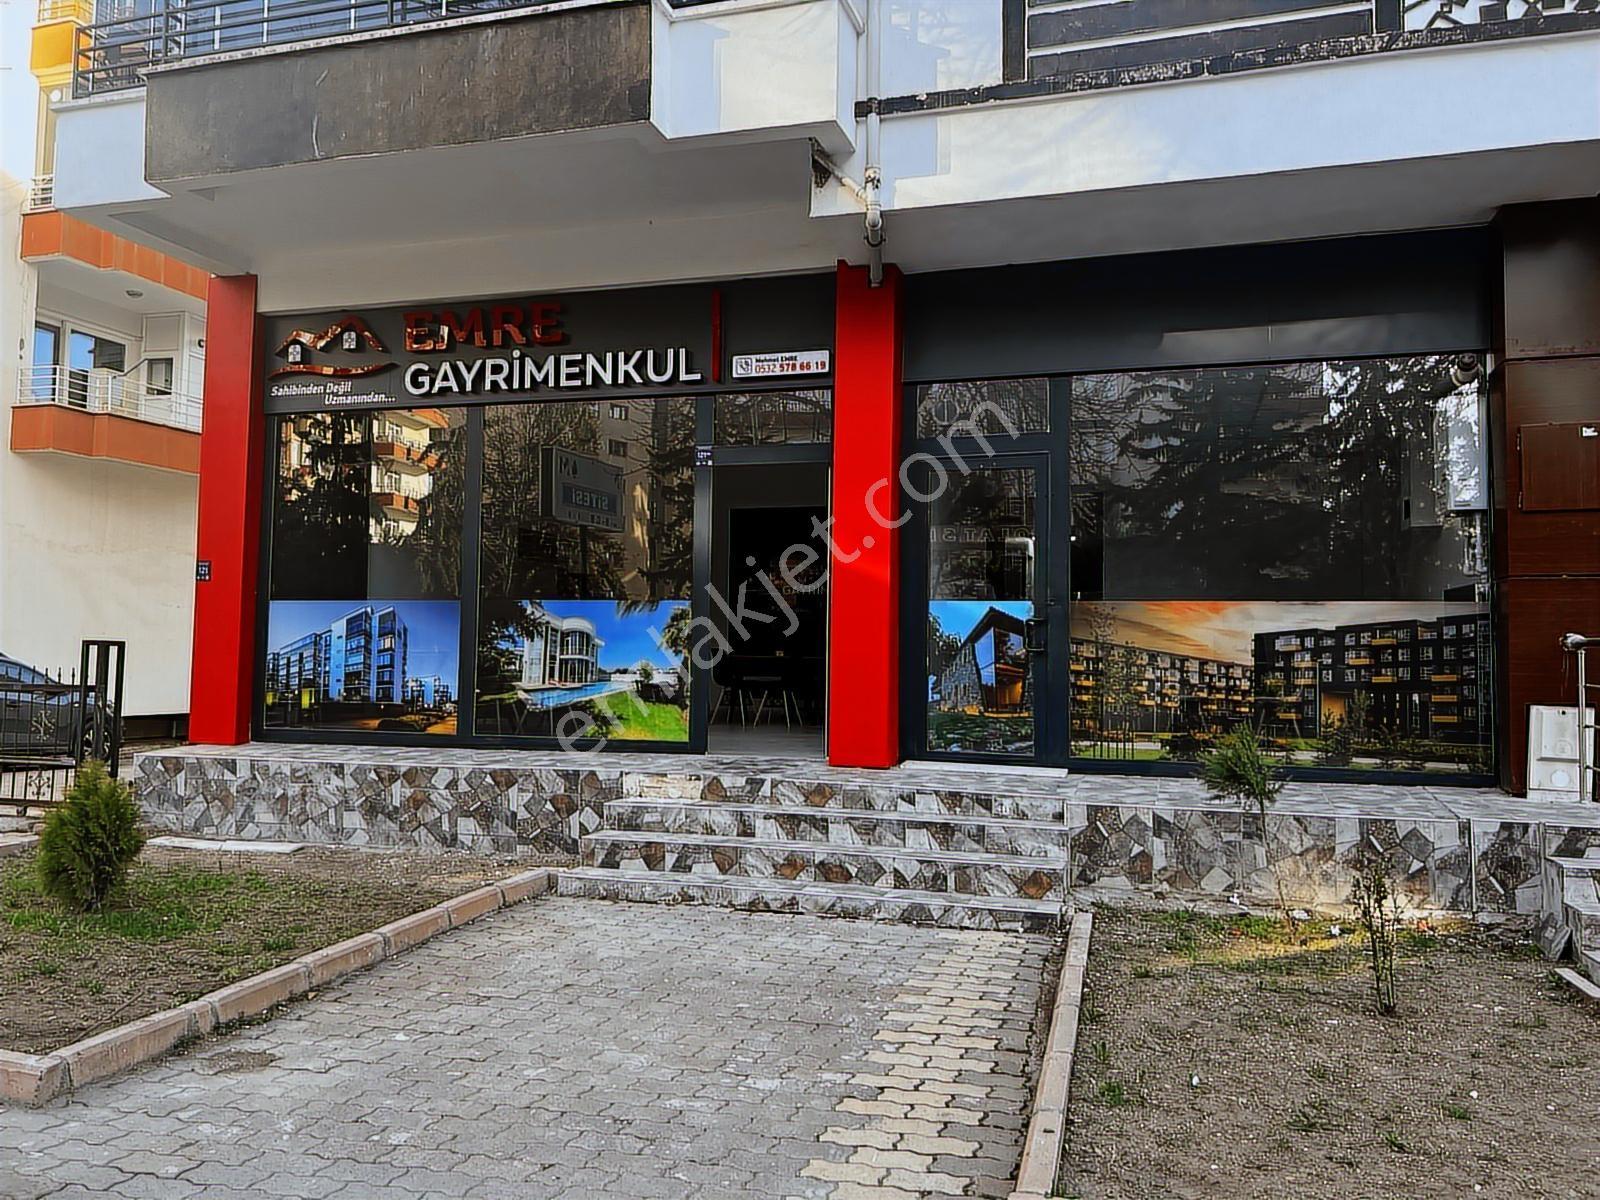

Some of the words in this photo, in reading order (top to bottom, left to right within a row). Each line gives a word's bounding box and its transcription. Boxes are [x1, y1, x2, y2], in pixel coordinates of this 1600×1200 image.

[402, 302, 565, 350] EMRE
[271, 384, 324, 396] Sahibinden
[326, 381, 352, 394] Değil
[404, 347, 702, 395] GAYRİMENKUL
